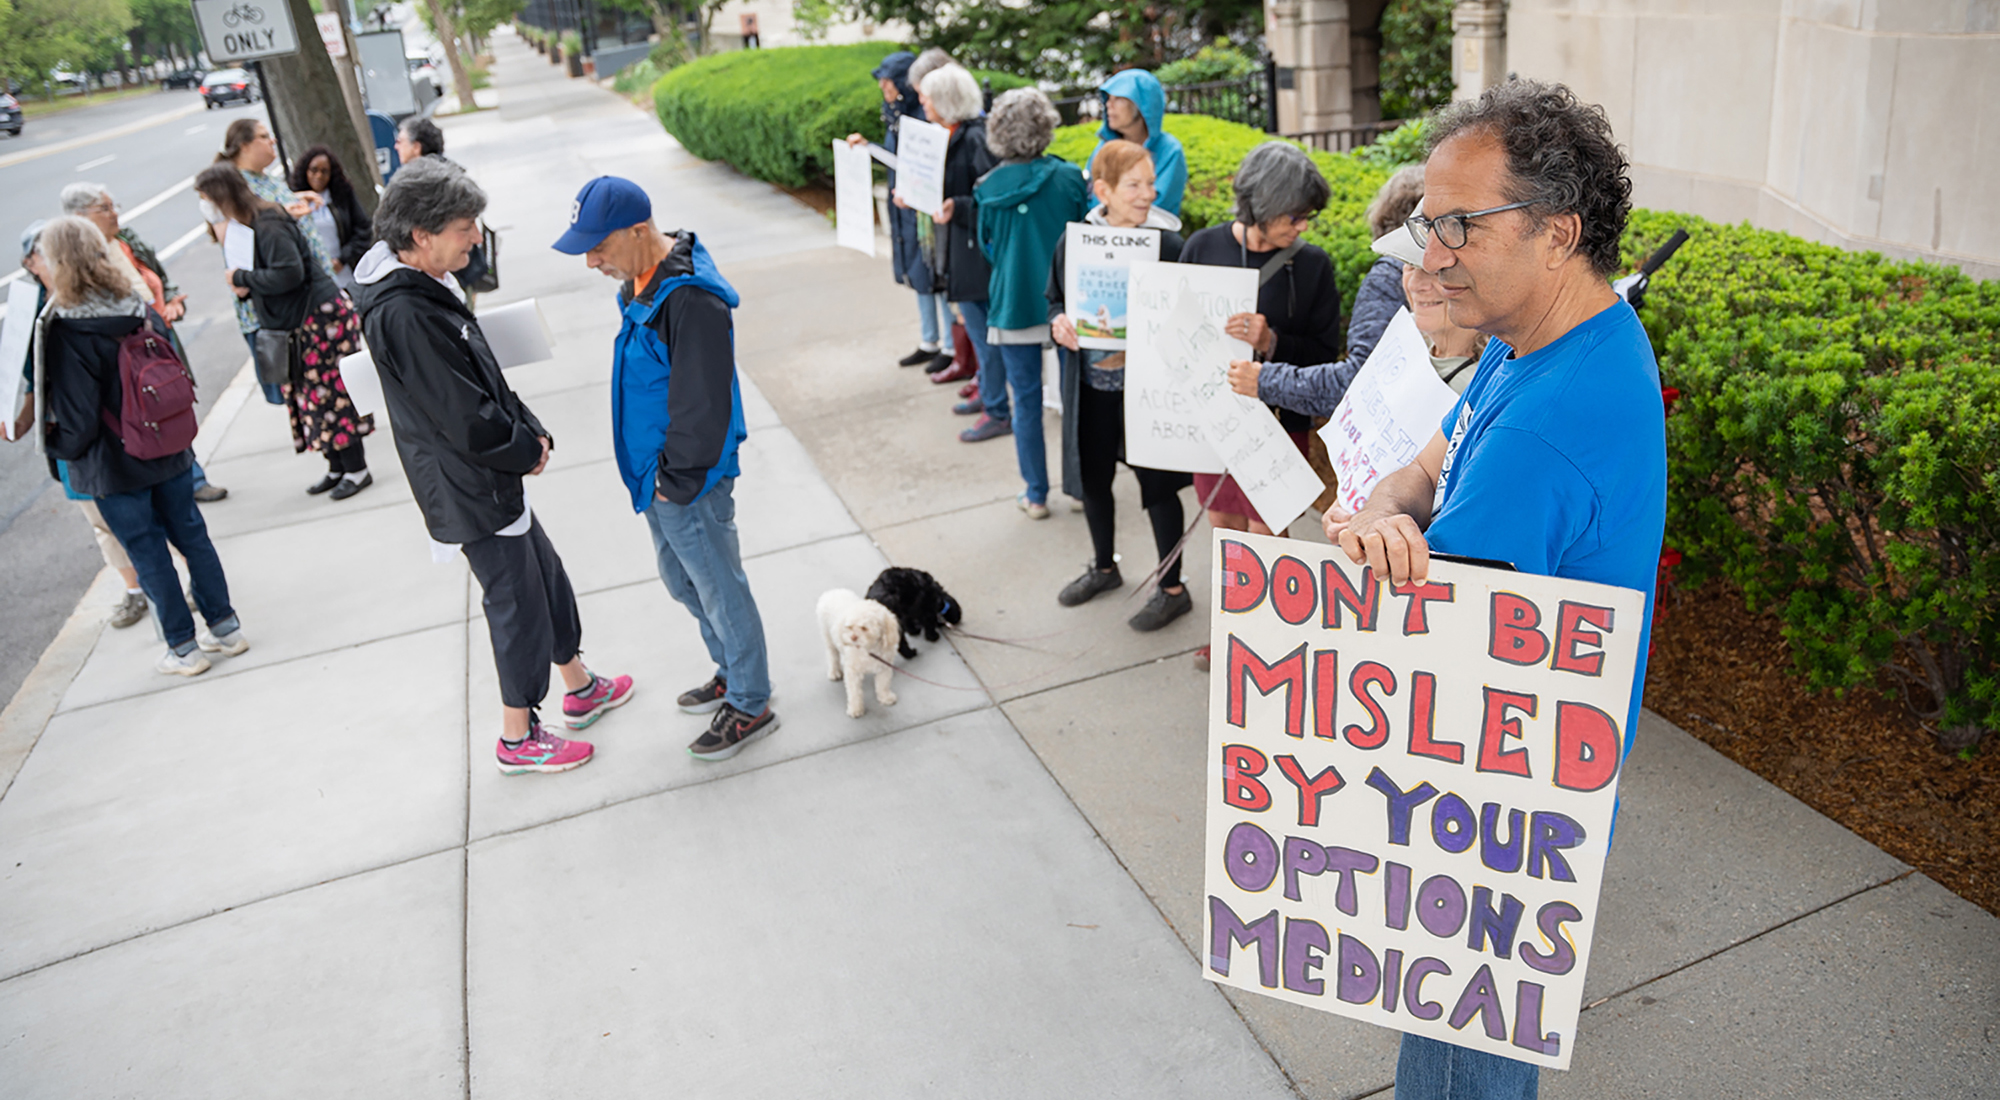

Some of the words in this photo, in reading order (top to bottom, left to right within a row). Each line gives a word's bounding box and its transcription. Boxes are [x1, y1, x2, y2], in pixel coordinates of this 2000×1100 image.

[223, 27, 275, 55] ONLY
[1082, 234, 1107, 246] THIS
[1111, 235, 1151, 247] CLINIC
[1098, 280, 1127, 290] SHEE
[1487, 590, 1616, 678] BE
[1226, 632, 1625, 793] MISLED
[1221, 742, 1347, 827] BY
[1364, 765, 1588, 883] YOUR
[1223, 821, 1583, 976] OPTIONS
[1207, 894, 1562, 1058] MEDICAL
